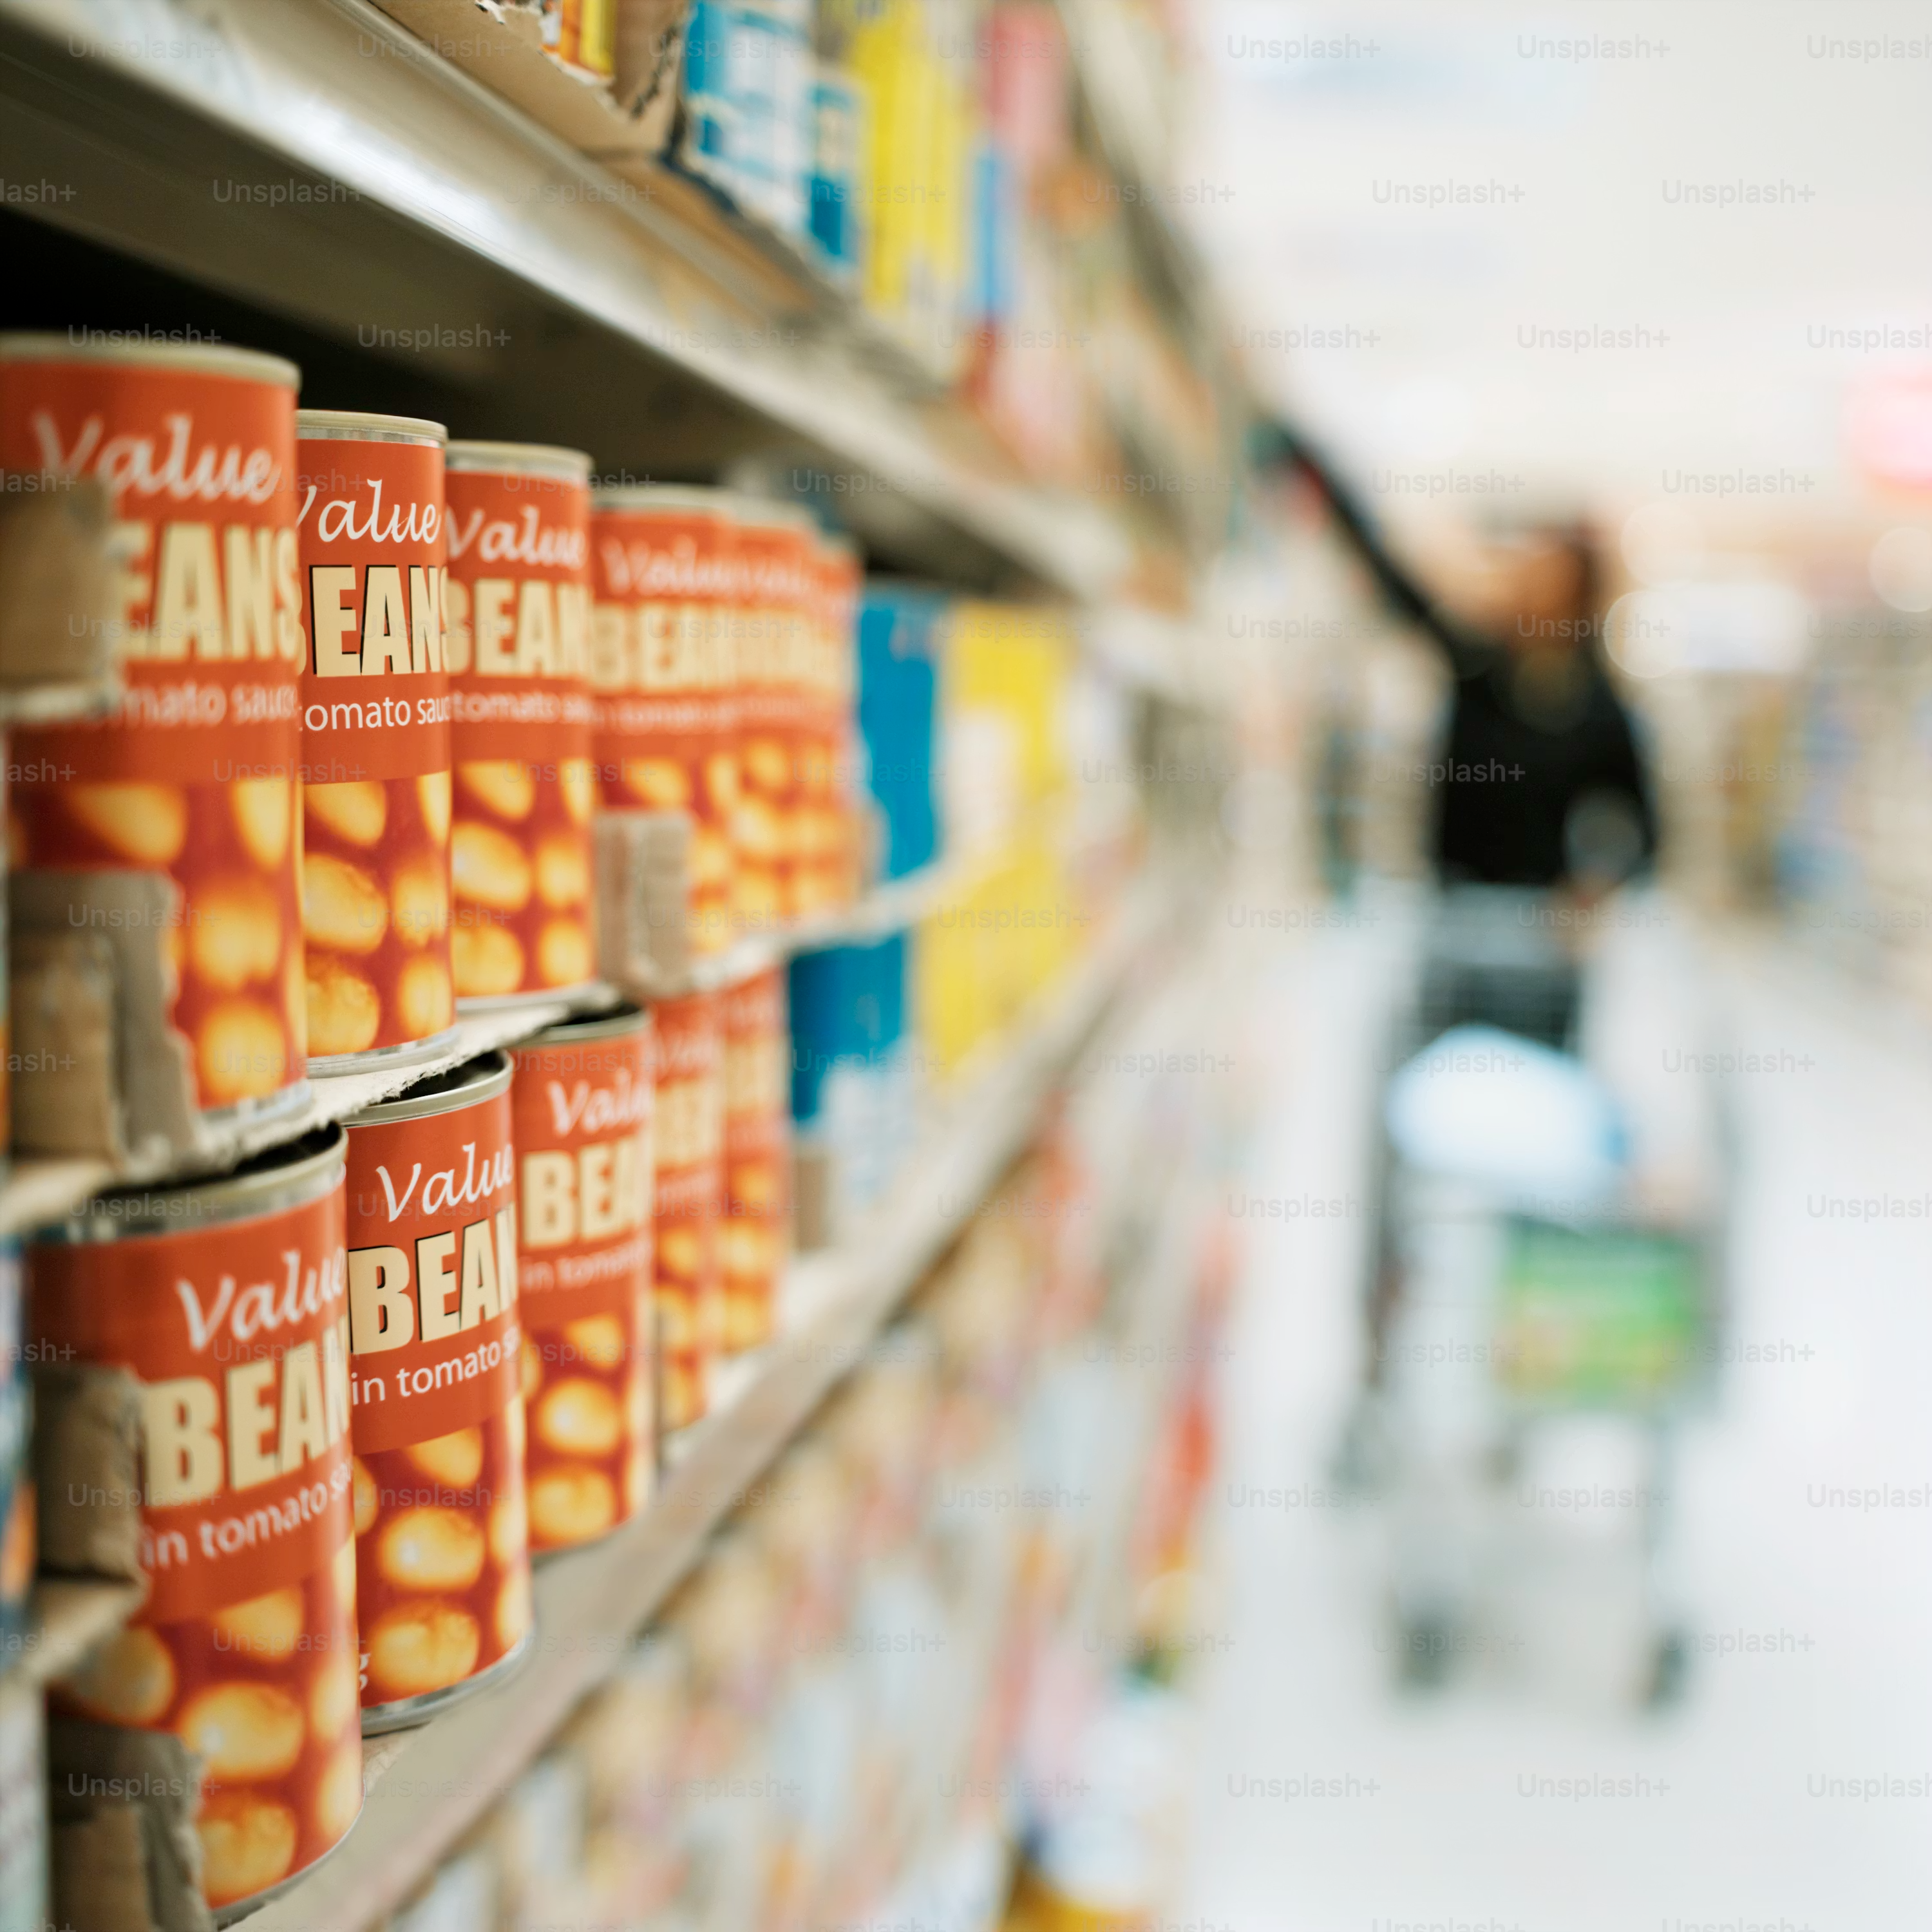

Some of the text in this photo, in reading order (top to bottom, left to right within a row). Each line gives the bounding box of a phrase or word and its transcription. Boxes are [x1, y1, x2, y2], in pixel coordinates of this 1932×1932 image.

[106, 521, 300, 661] EANS
[299, 697, 412, 731] omato
[347, 1200, 519, 1355] BEAN
[144, 1312, 352, 1509] BEAN
[351, 1372, 386, 1406] in
[395, 1340, 502, 1398] tomato
[200, 1481, 328, 1560] tomato
